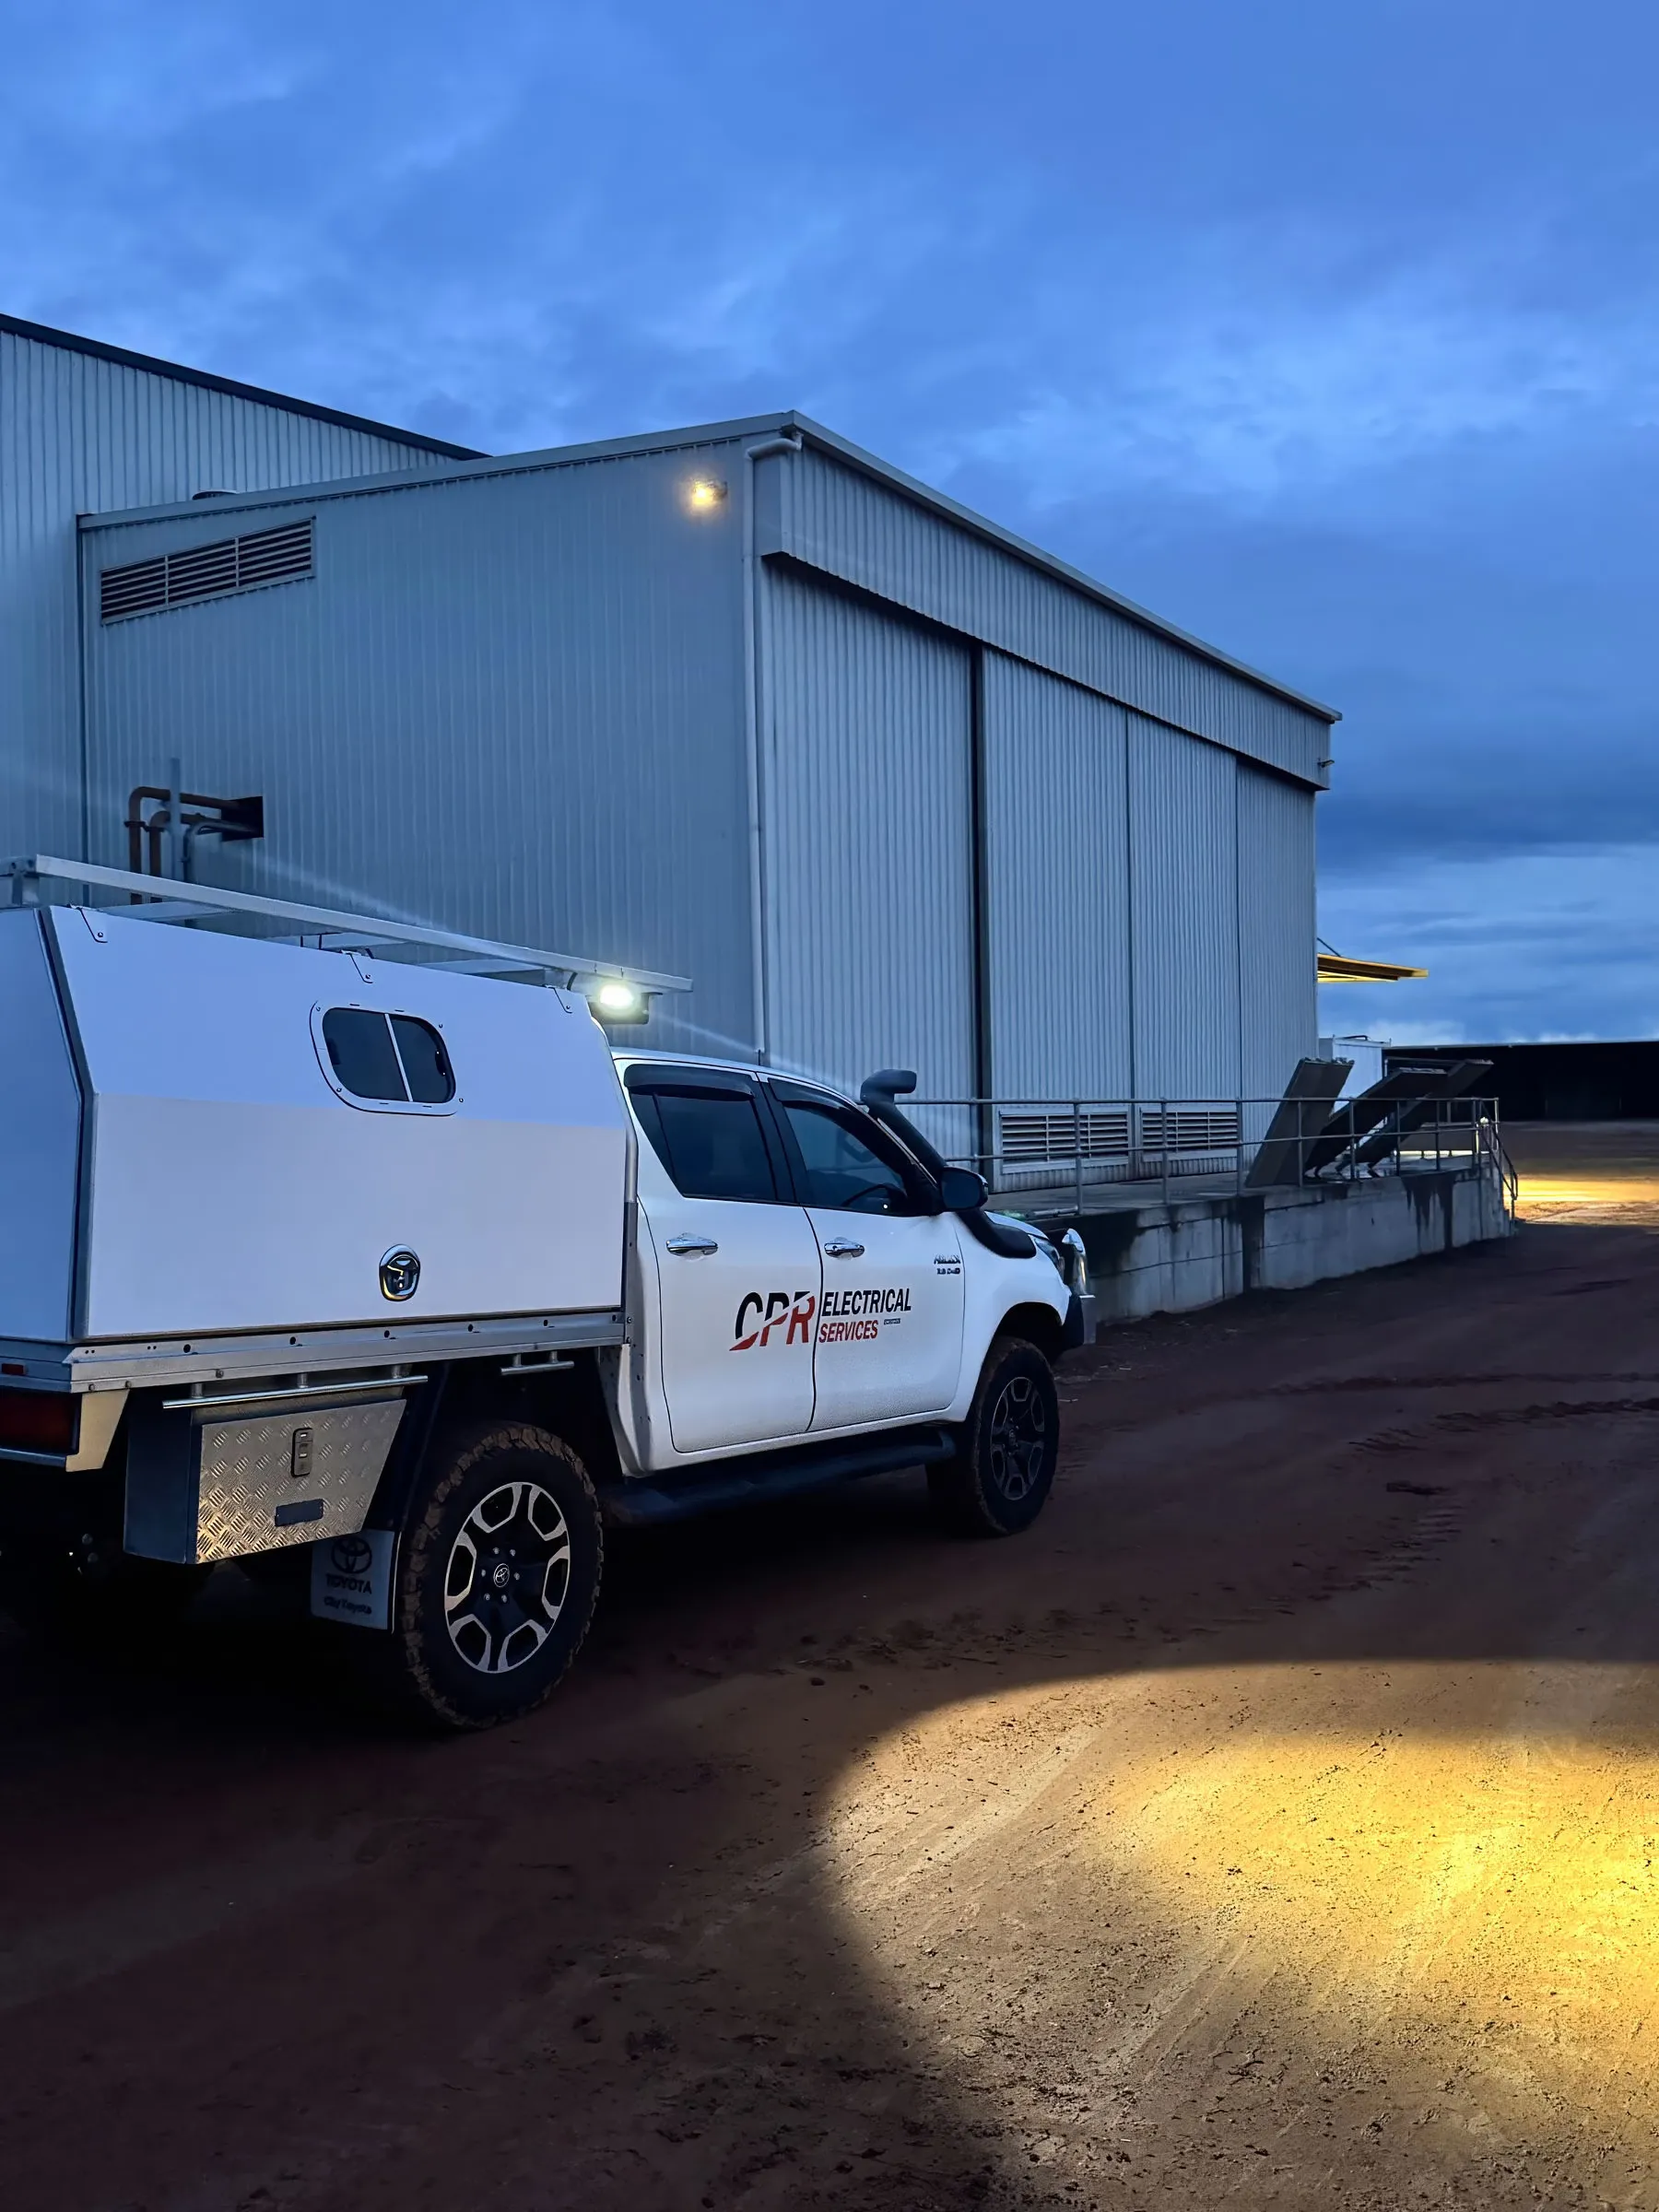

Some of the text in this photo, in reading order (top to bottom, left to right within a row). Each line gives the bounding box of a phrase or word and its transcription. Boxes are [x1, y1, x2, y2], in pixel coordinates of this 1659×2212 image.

[821, 1288, 912, 1317] ELECTRICAL
[729, 1291, 815, 1352] CPR
[818, 1320, 878, 1343] SERVICES
[325, 1573, 372, 1594] TOYOTA
